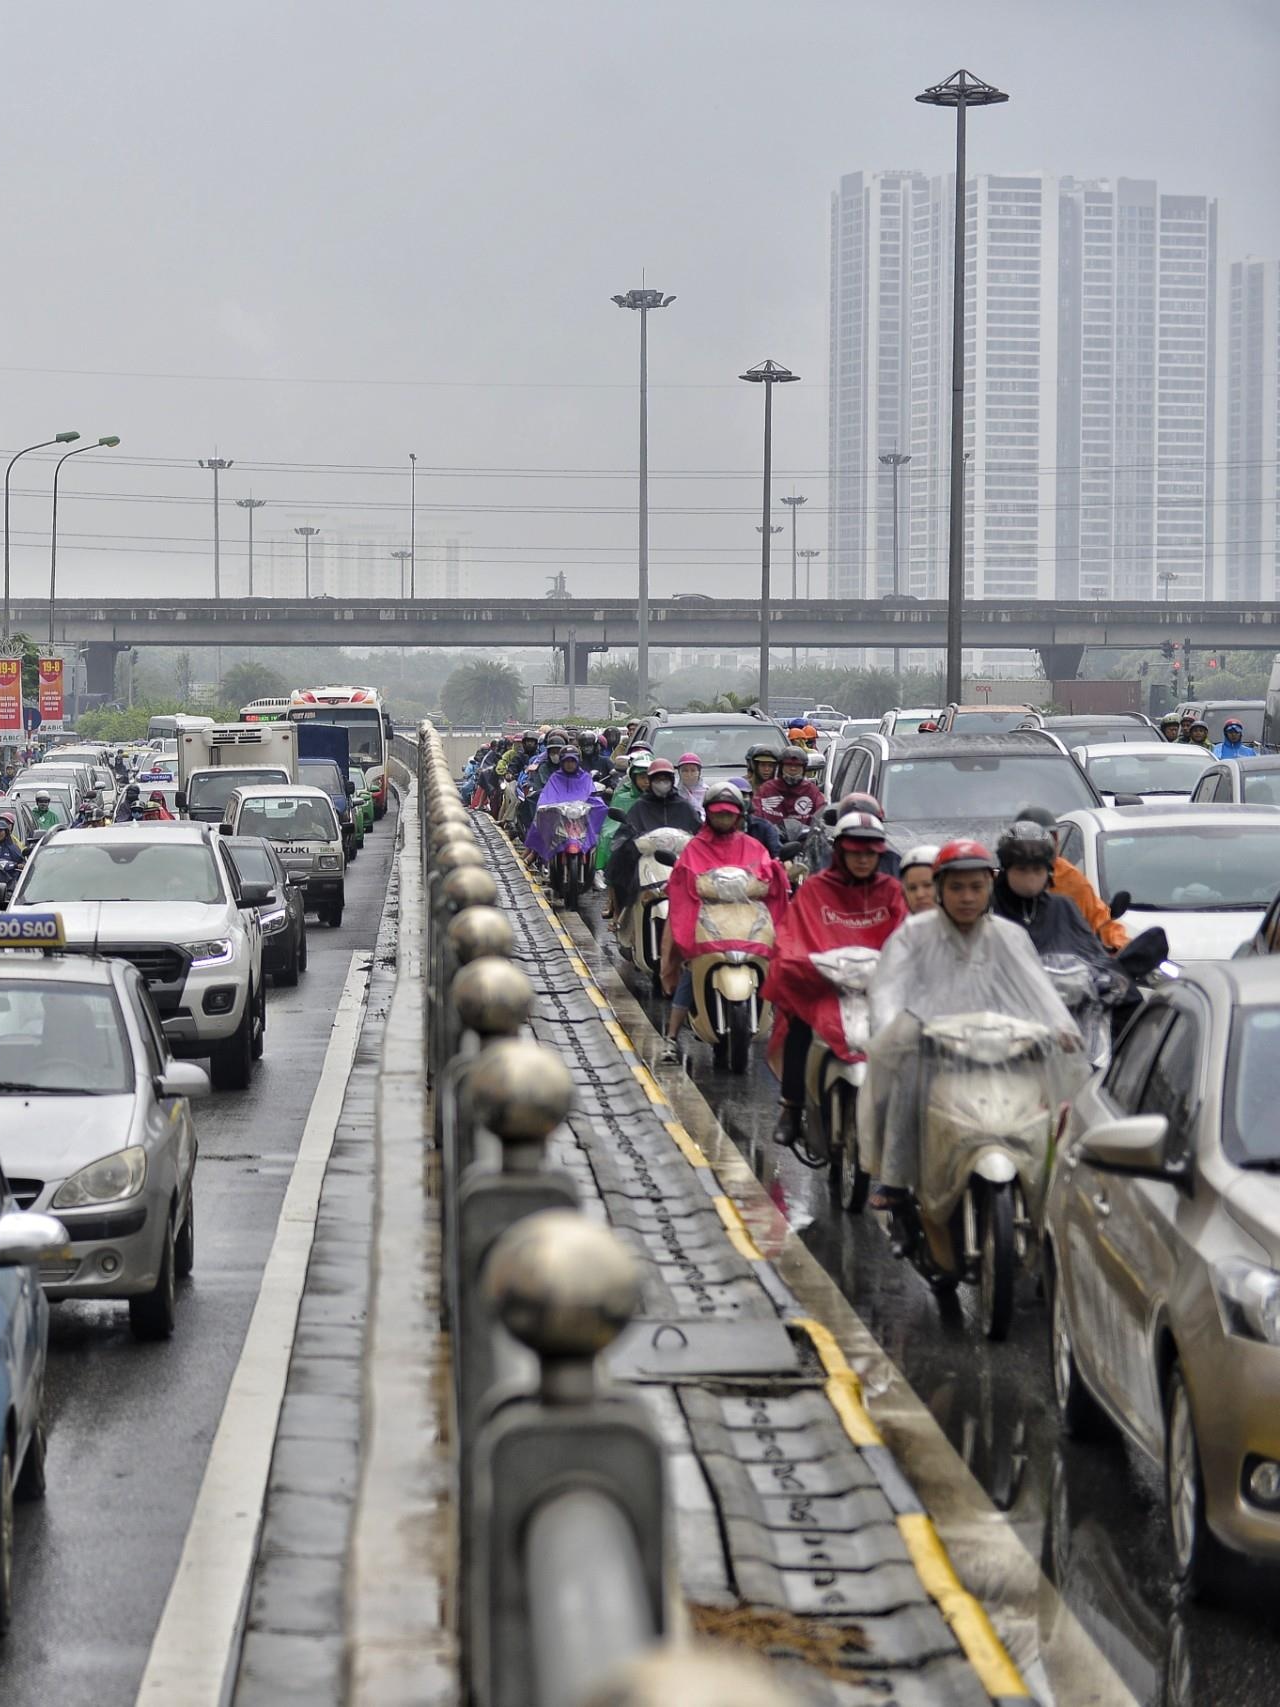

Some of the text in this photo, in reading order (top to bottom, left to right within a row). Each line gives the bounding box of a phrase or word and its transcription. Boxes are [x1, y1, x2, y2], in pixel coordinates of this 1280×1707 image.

[43, 661, 60, 672] 19-8
[275, 846, 310, 854] UZUKI
[22, 921, 57, 937] SAO
